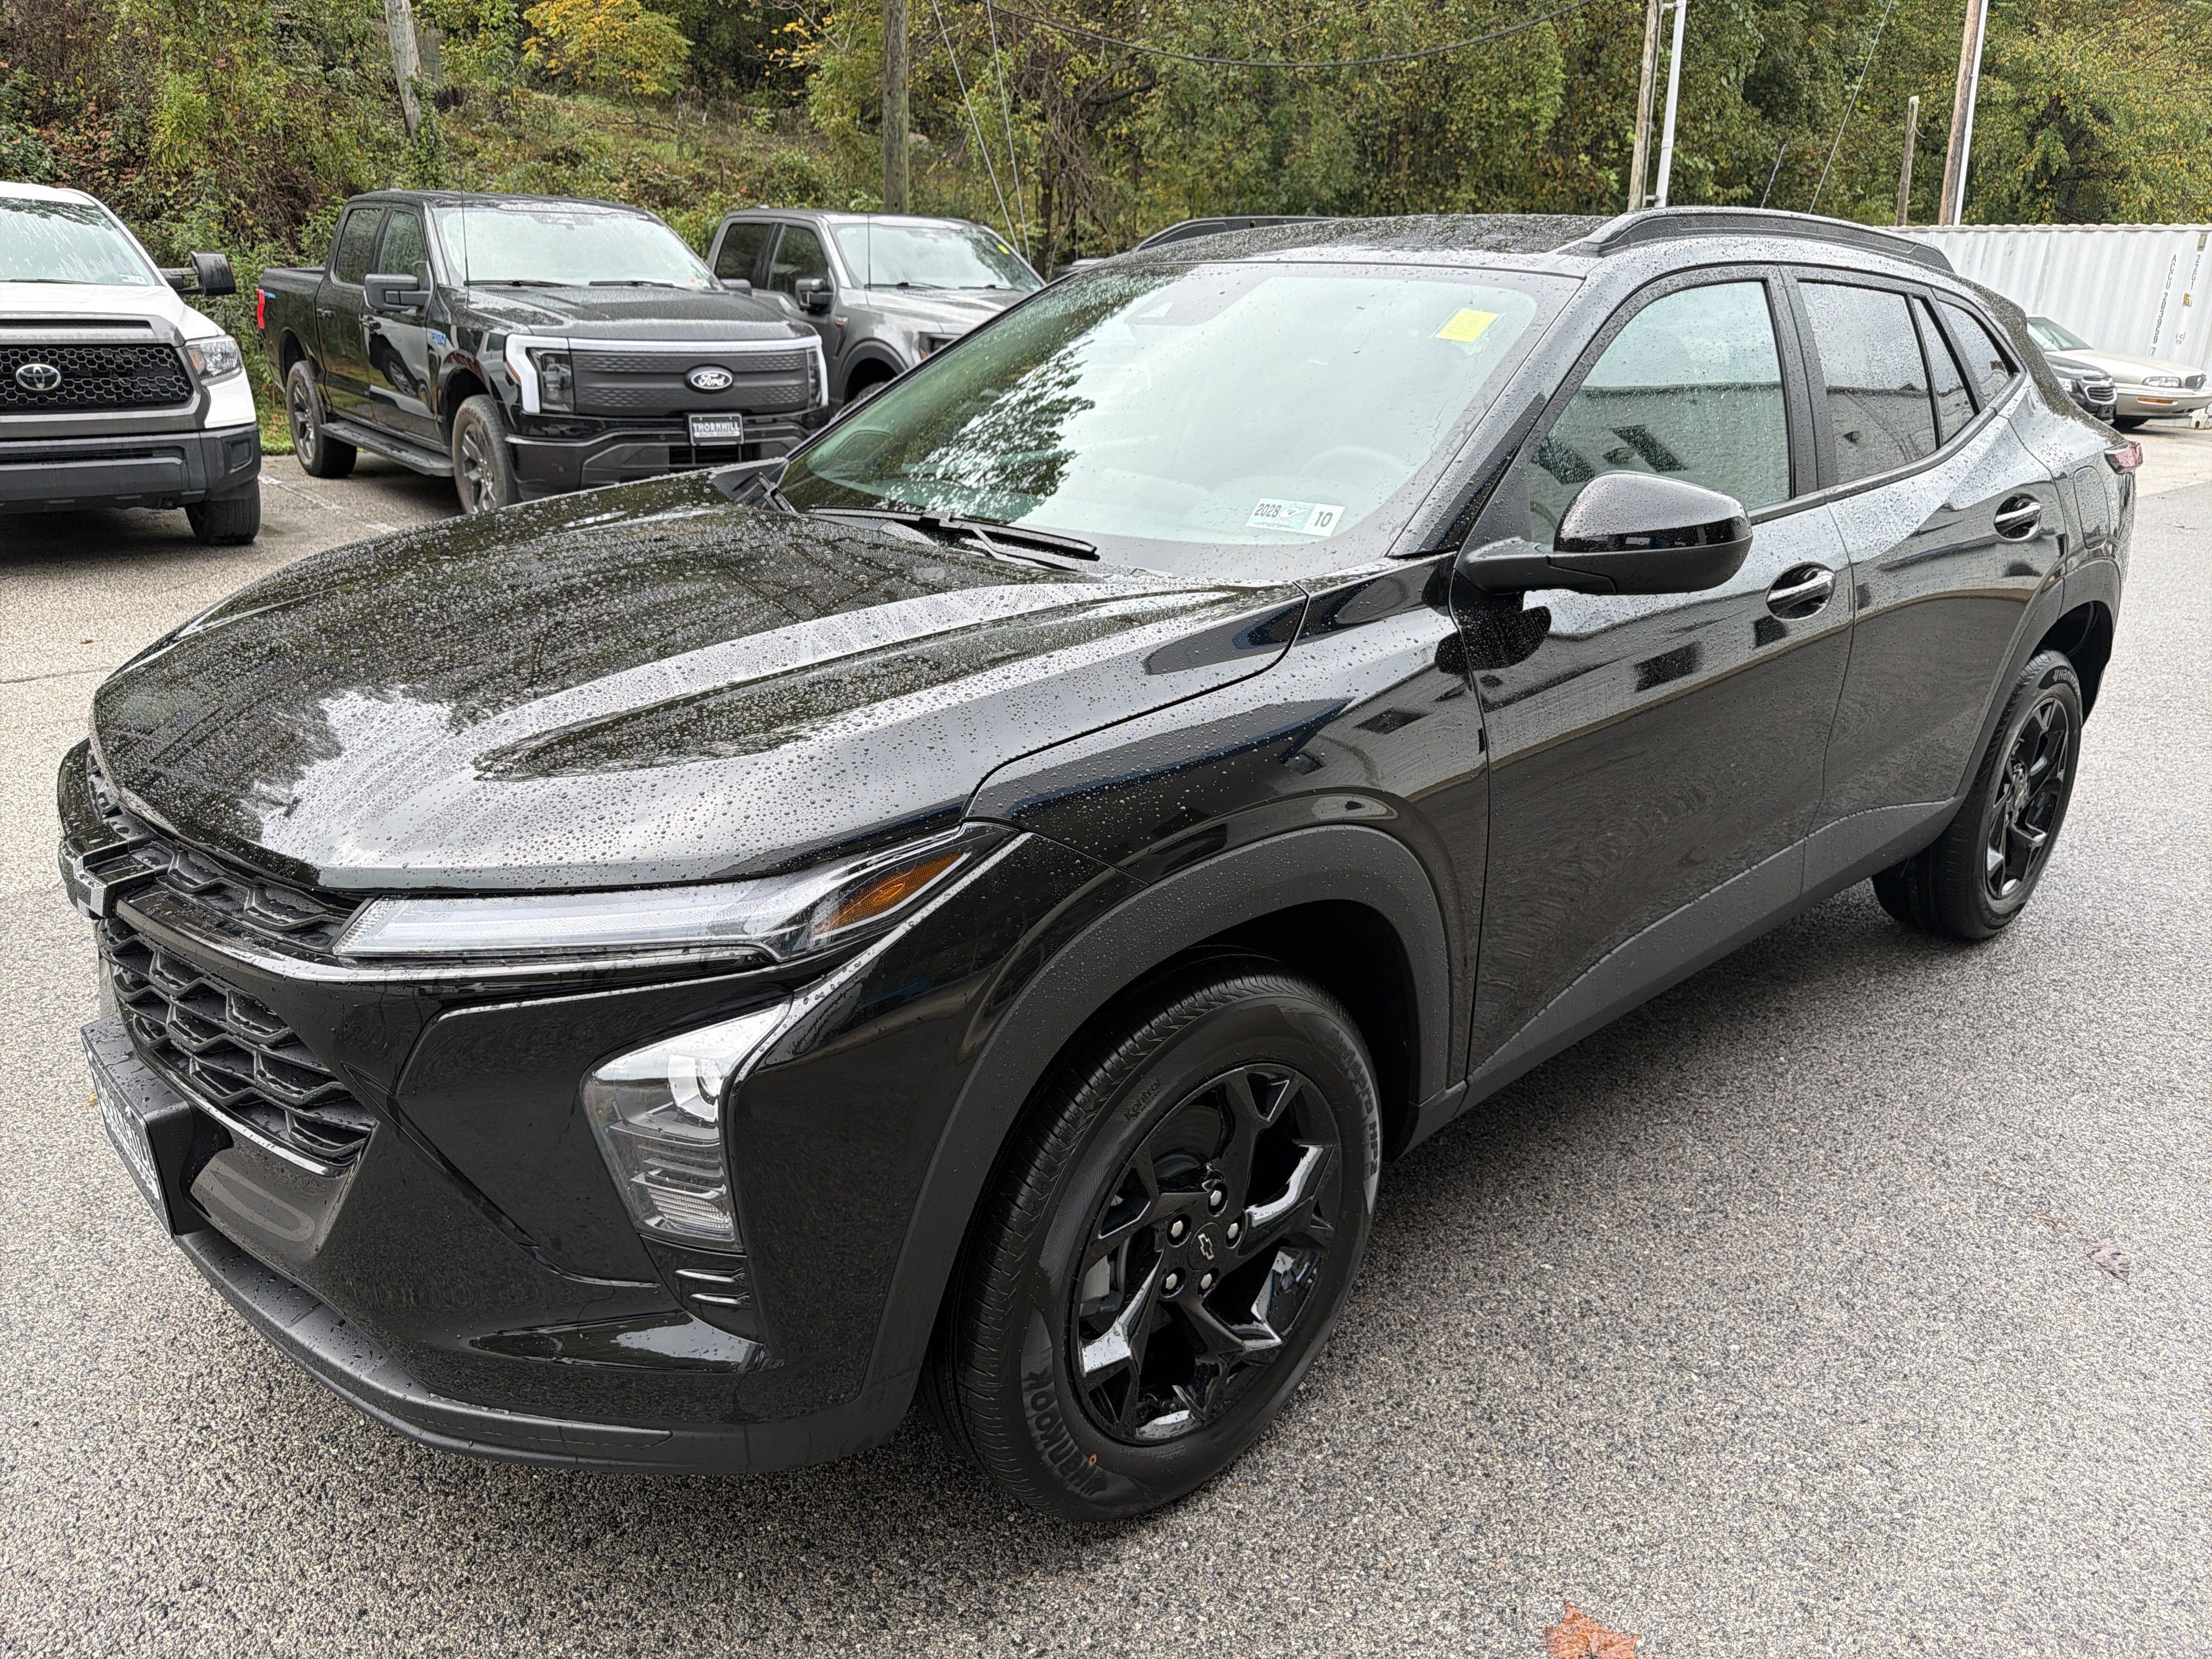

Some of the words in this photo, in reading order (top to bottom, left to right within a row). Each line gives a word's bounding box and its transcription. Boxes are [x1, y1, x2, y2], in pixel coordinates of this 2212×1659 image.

[2166, 254, 2176, 289] ACCU
[698, 374, 725, 386] Ford
[692, 421, 740, 432] THORNHILL
[1254, 503, 1282, 518] 2028
[1314, 511, 1333, 527] 10
[1023, 1366, 1098, 1489] Hankook
